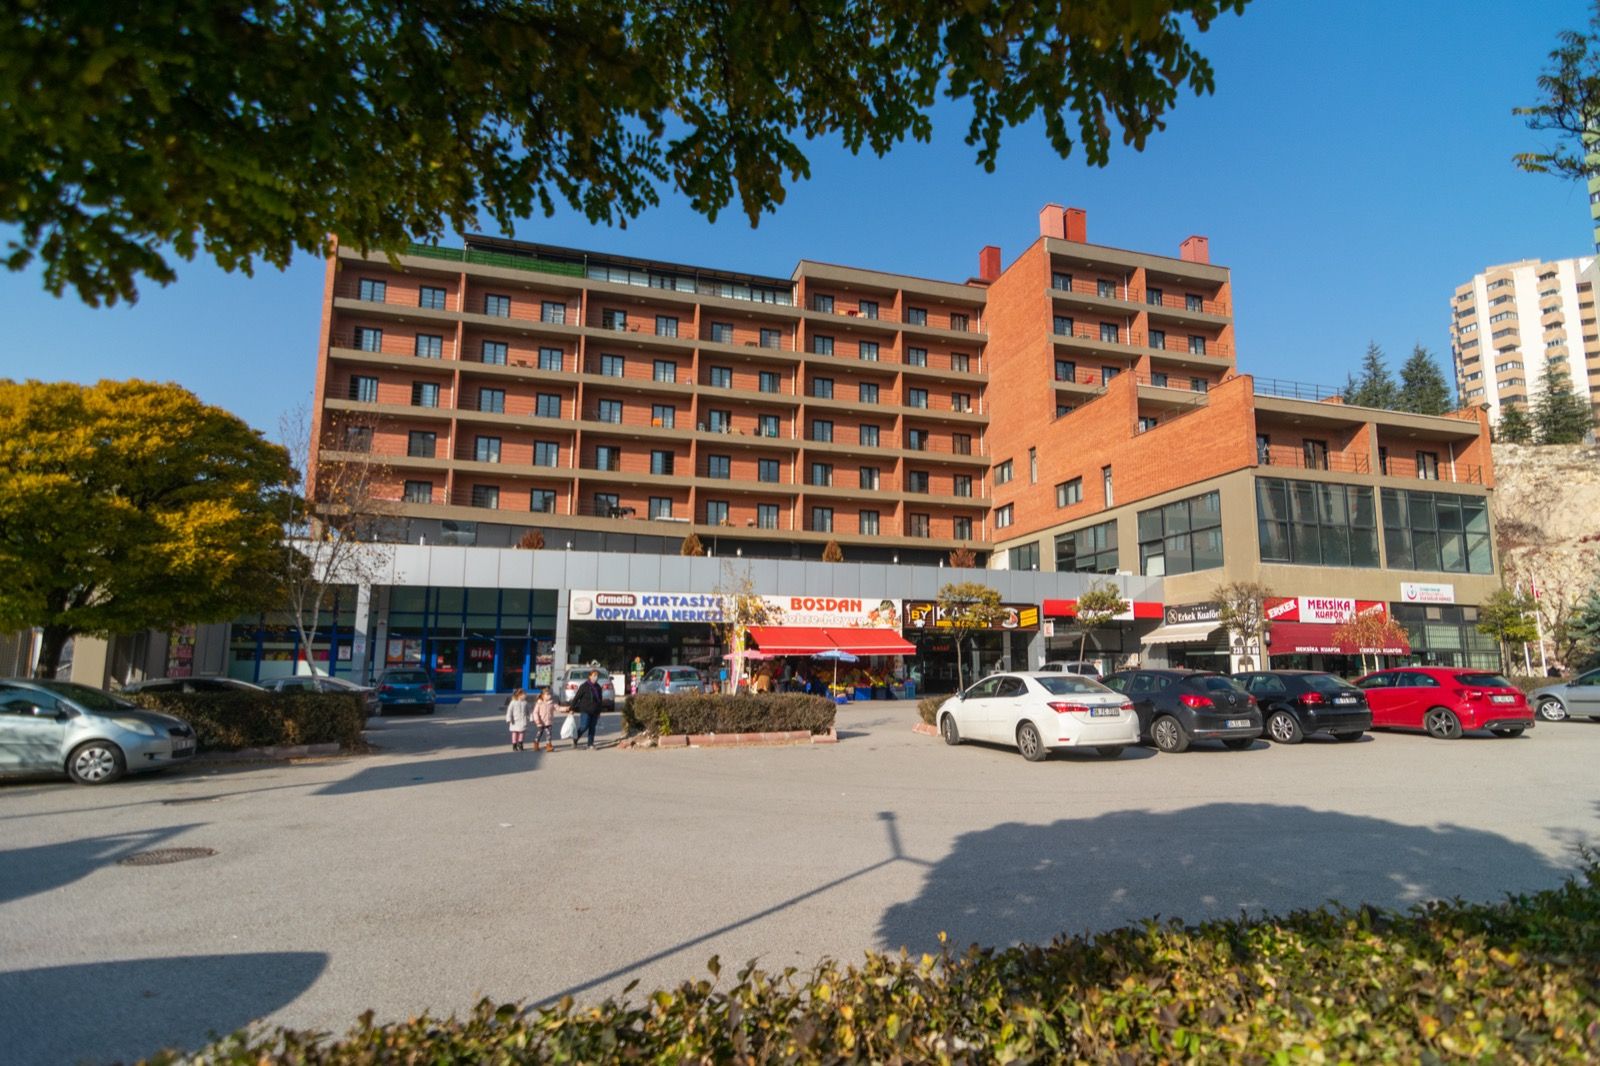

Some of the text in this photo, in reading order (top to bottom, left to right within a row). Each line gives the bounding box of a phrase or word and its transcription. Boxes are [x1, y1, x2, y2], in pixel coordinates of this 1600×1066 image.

[790, 597, 862, 613] BOSDAN
[1307, 598, 1350, 611] MEKSİKA
[596, 608, 723, 621] KOPYALAMA MERKEZİ
[911, 610, 928, 620] BY
[1178, 611, 1196, 622] Erkek
